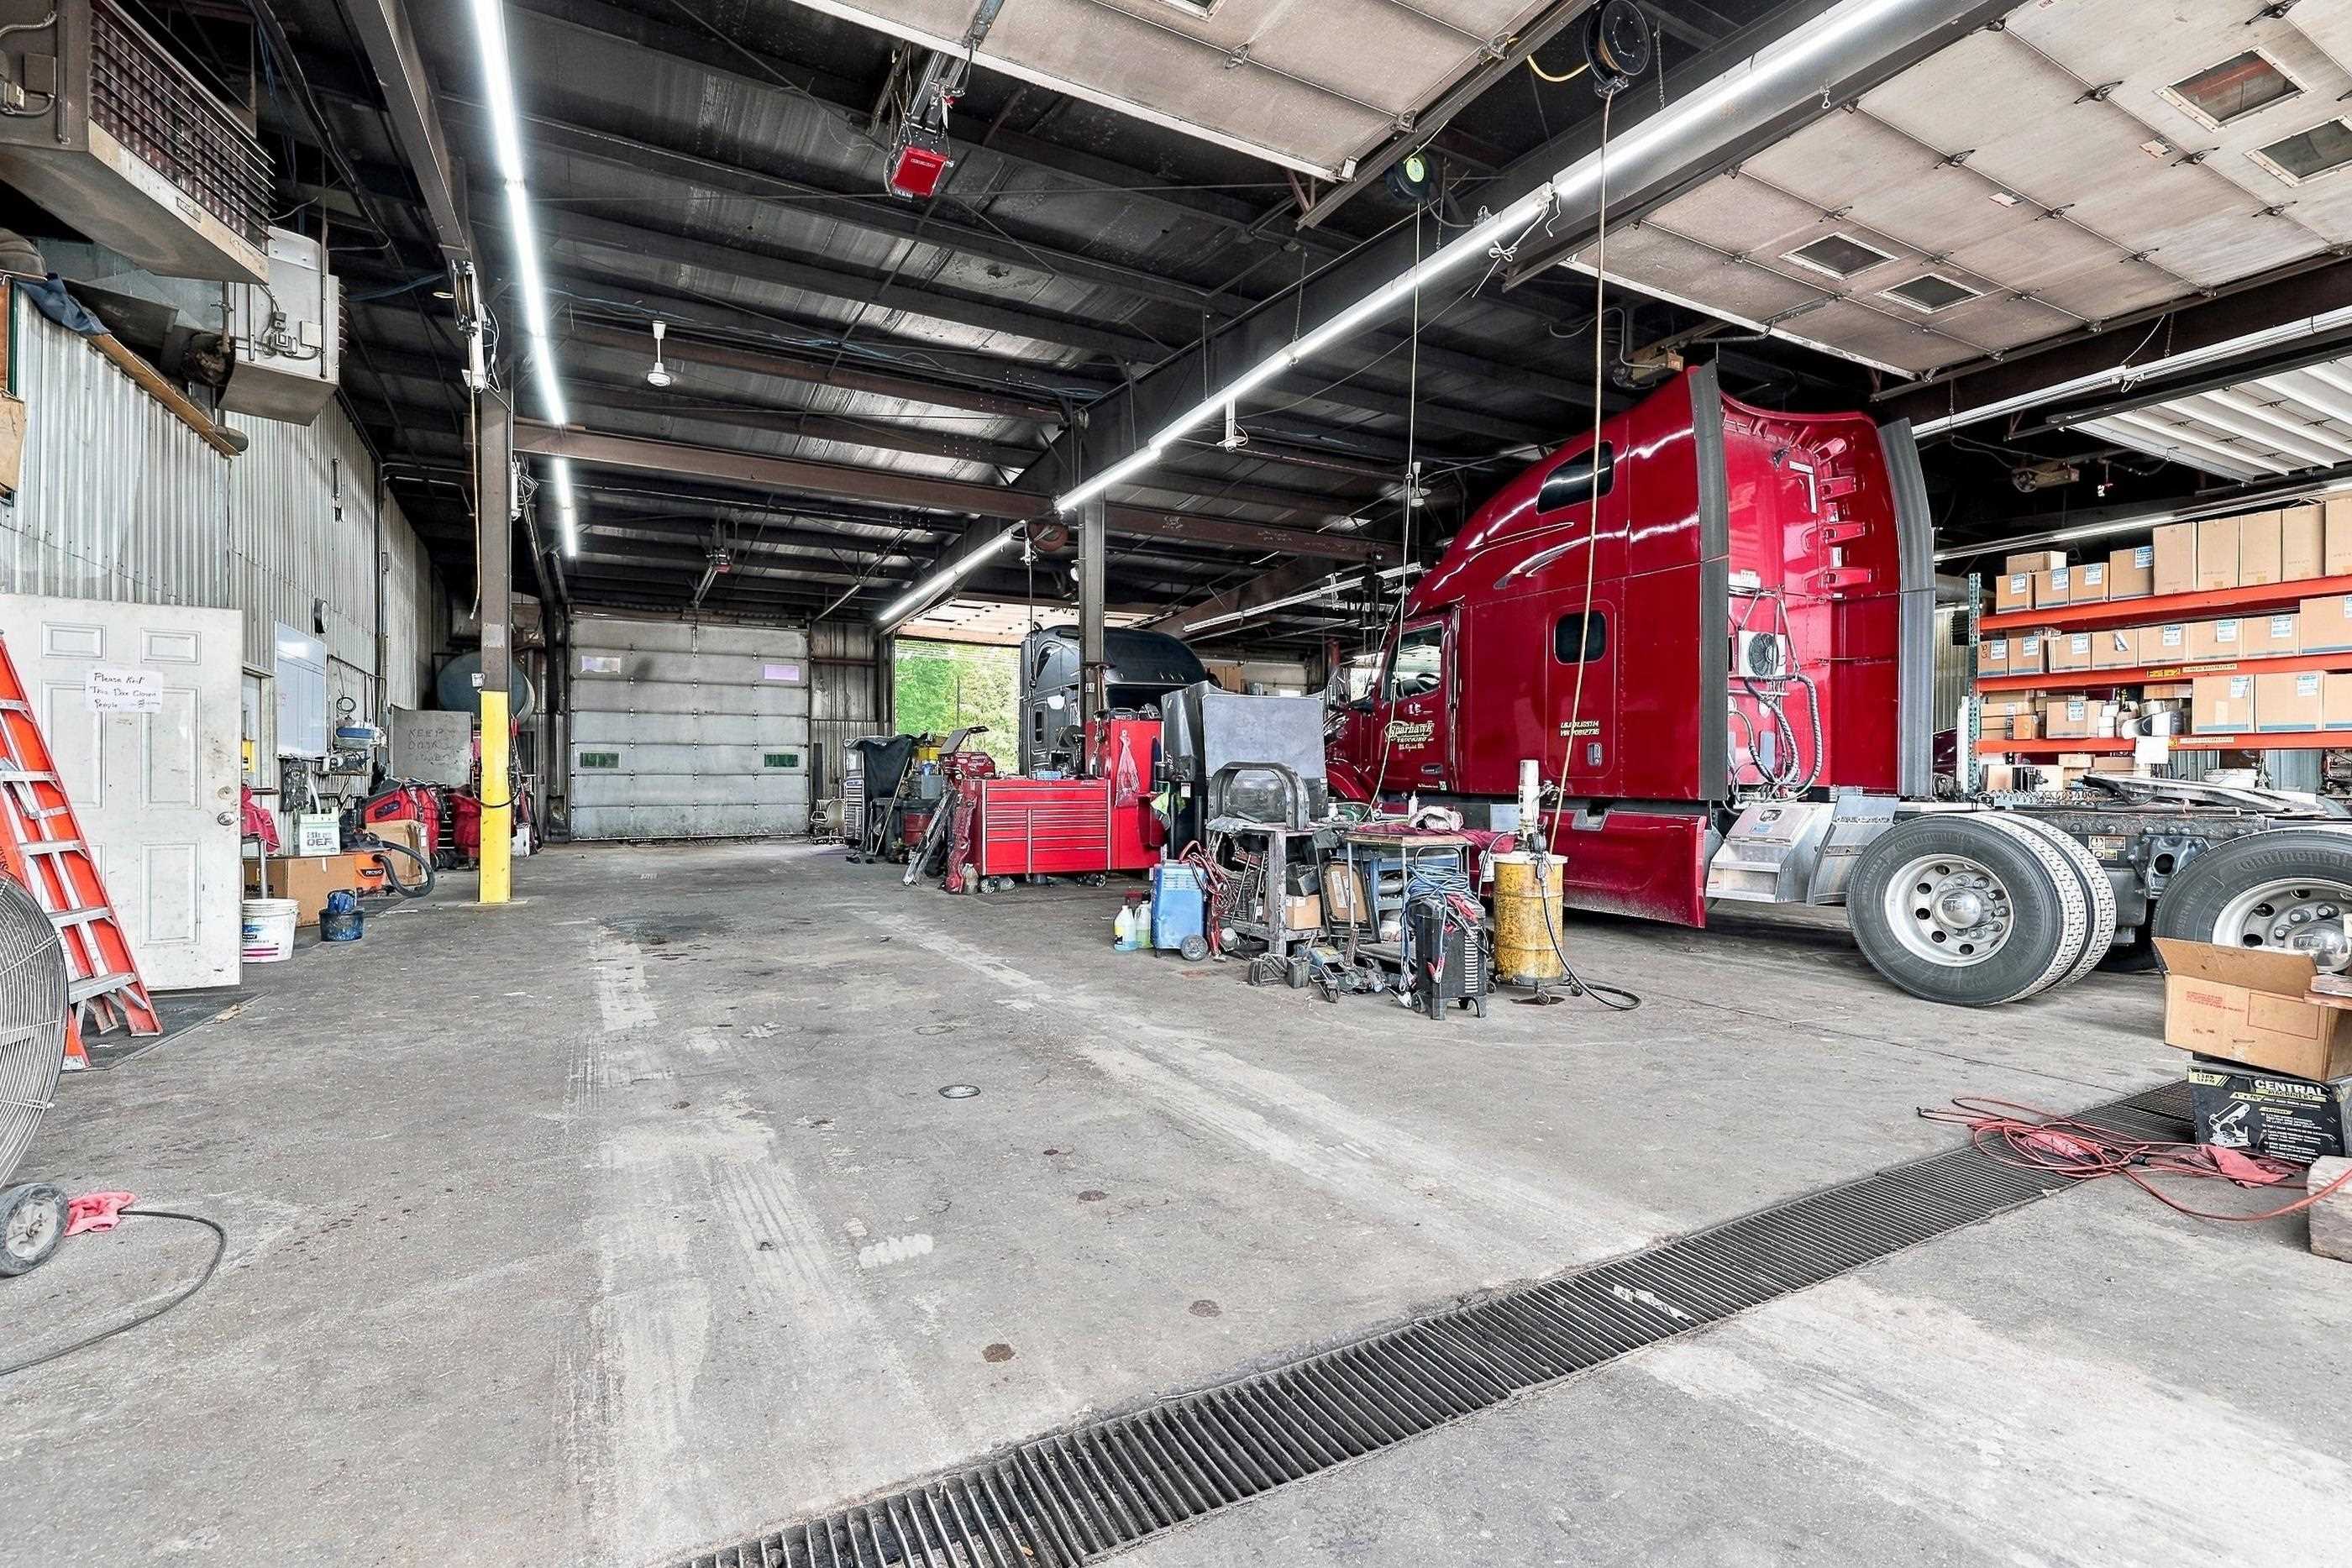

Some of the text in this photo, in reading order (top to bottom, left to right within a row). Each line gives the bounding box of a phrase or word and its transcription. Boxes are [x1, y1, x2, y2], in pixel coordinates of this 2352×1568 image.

[94, 672, 122, 683] Please
[89, 685, 108, 695] This
[94, 698, 118, 710] People
[408, 728, 444, 739] KEEP
[1389, 722, 1435, 737] Sparhawk
[307, 838, 333, 847] DEF
[2255, 1079, 2323, 1096] CENTRAL
[2268, 1089, 2313, 1100] MACHINERY
